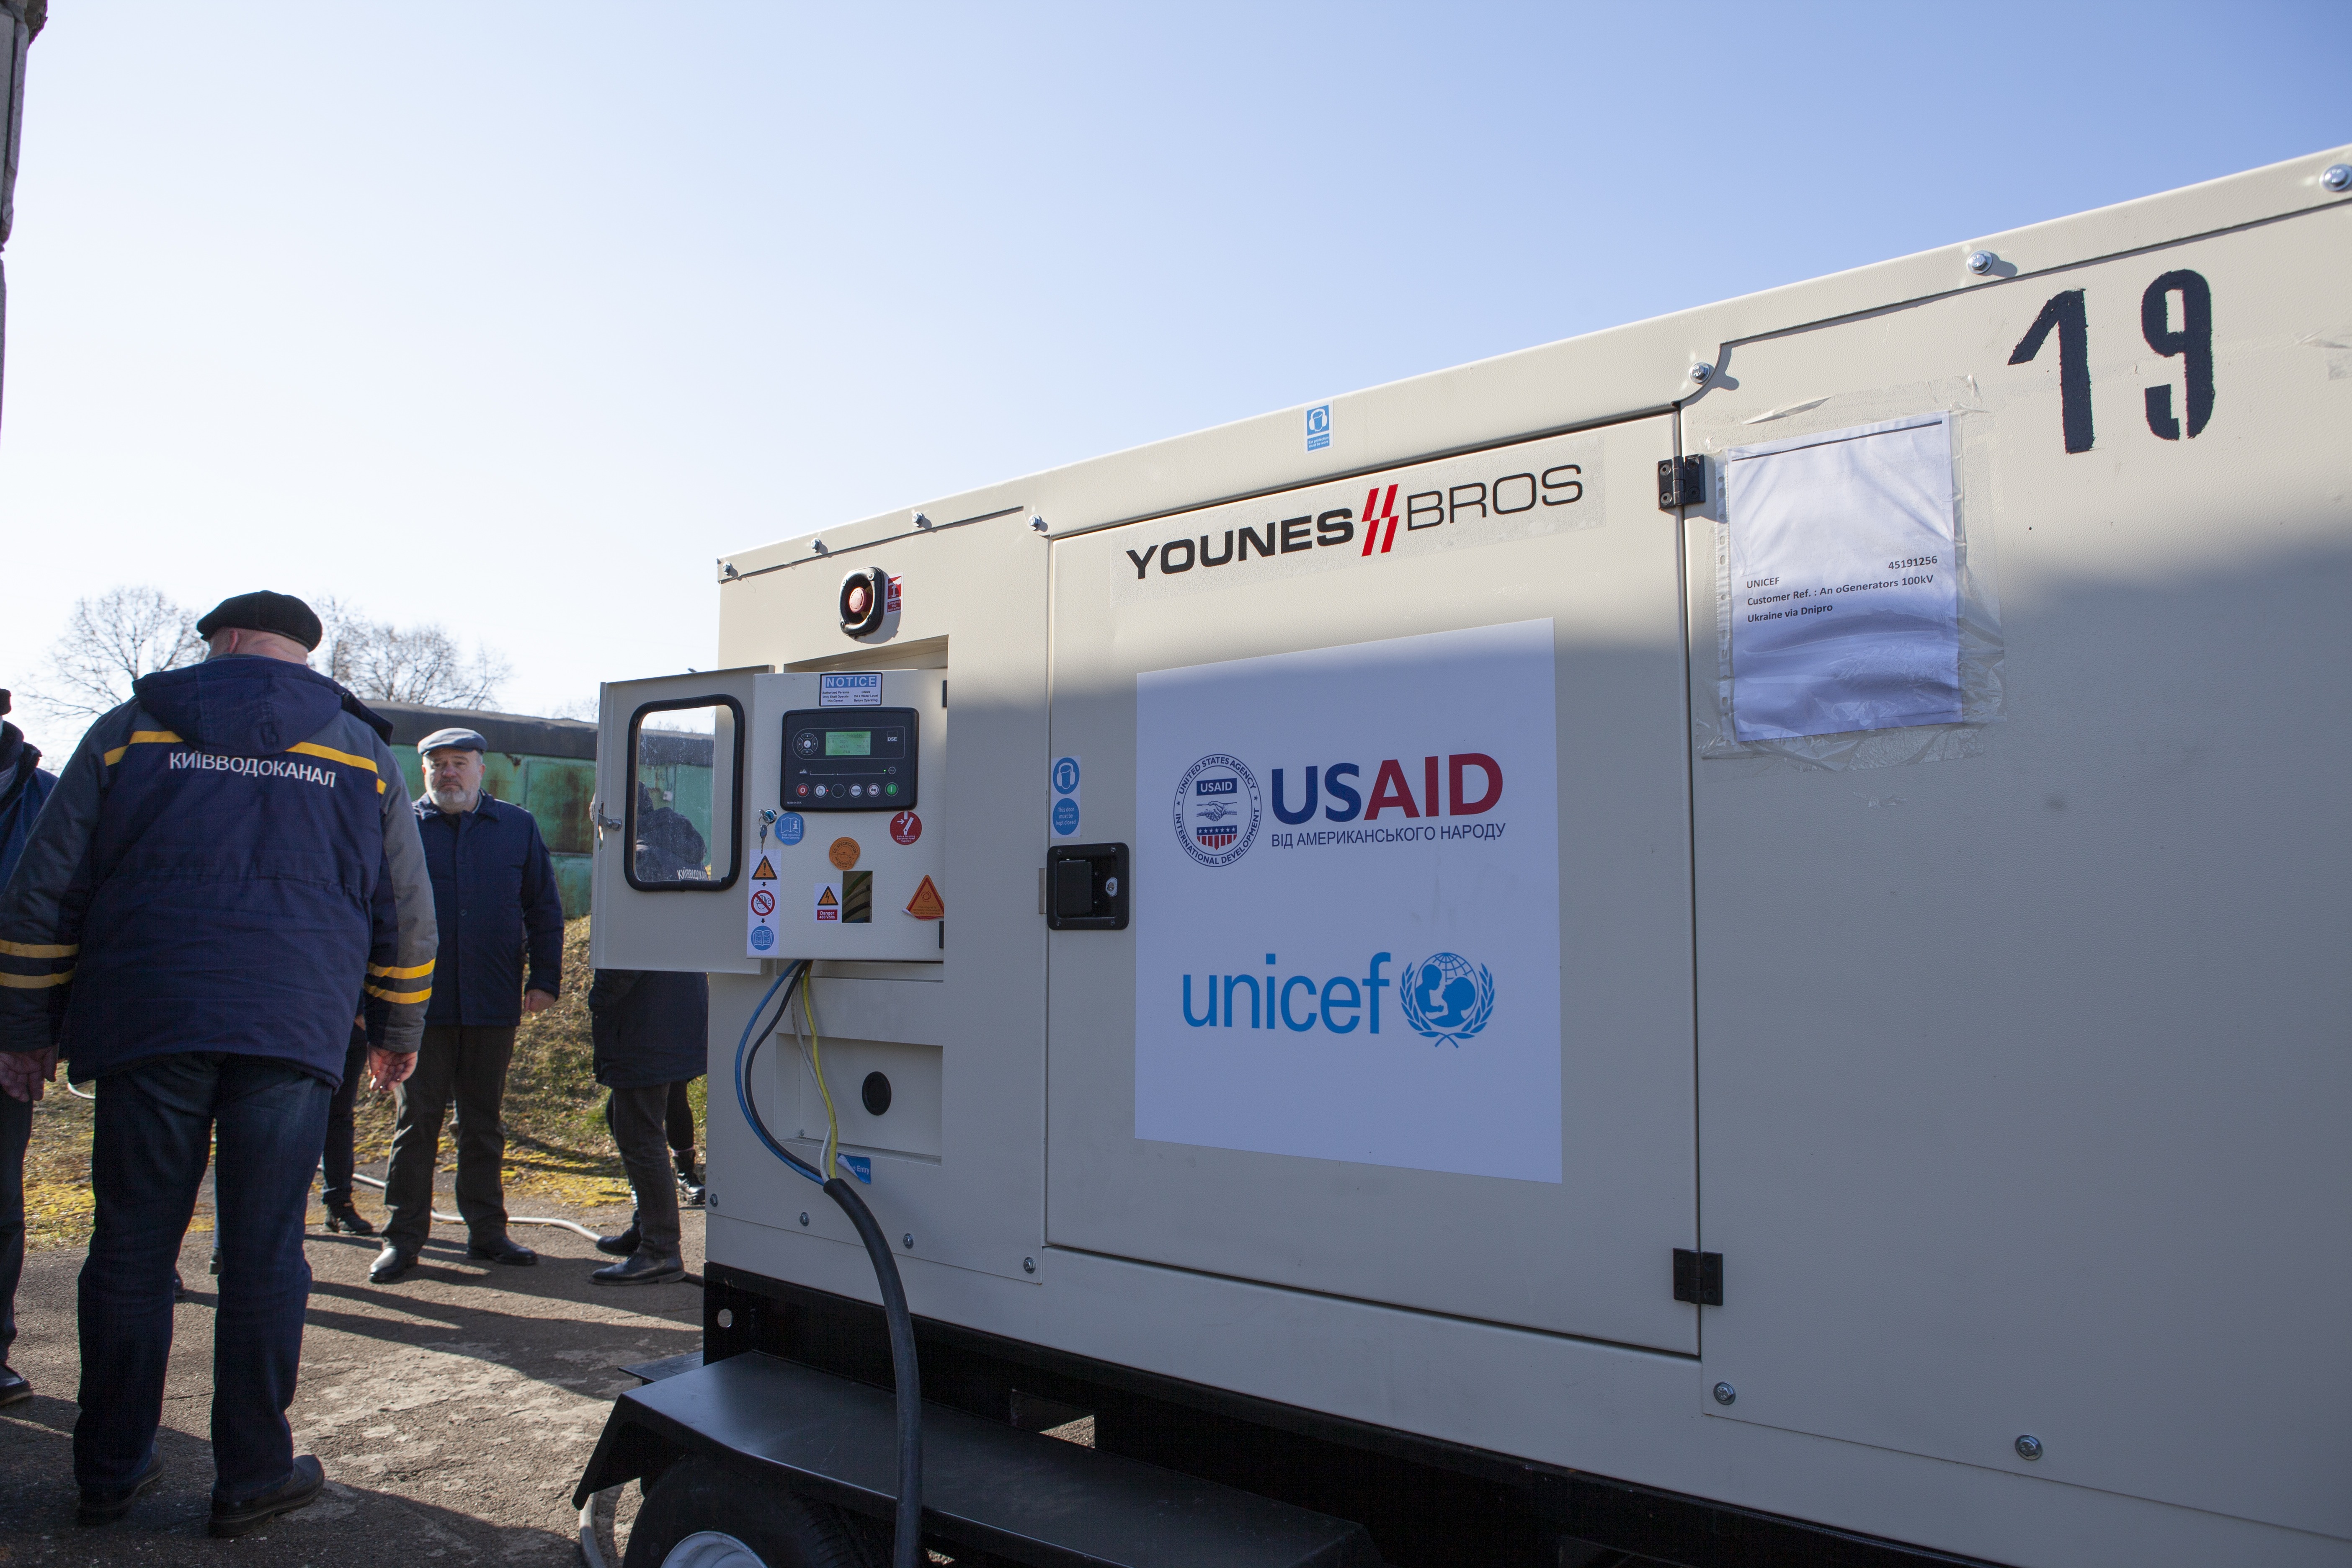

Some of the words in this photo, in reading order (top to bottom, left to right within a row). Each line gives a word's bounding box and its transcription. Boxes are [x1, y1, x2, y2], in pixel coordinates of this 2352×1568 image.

[2007, 268, 2215, 454] 19
[1126, 508, 1354, 580] YOUNES
[1407, 464, 1583, 531] BROS
[1888, 555, 1938, 570] 45191256
[1747, 577, 1780, 588] UNICEF
[1747, 594, 1791, 606] Customer
[1793, 589, 1811, 599] Ref.
[1836, 580, 1898, 593] oGenerators
[1902, 574, 1934, 586] 100kV
[1748, 612, 1782, 622] Ukraine
[1785, 609, 1798, 617] via
[1801, 605, 1833, 615] Dnipro
[827, 676, 876, 687] NOTICE
[170, 750, 336, 788] КИЇВВОДОКАНАЛ
[1179, 764, 1201, 794] UNITED
[1202, 756, 1230, 768] STATES
[1230, 760, 1256, 789] AGENCY
[1200, 781, 1233, 792] USAID
[1271, 753, 1504, 825] USAID
[836, 841, 857, 854] SPECIFICATION
[1176, 813, 1219, 864] INTERNATIONAL
[1221, 807, 1260, 864] DEVELOPMENT
[1271, 833, 1293, 849] ВІД
[1297, 826, 1436, 846] АМЕРИКАНСЬКОГО
[1440, 823, 1506, 841] НАРОДУ
[1183, 951, 1391, 1034] unicef
[857, 1165, 869, 1175] Entry
